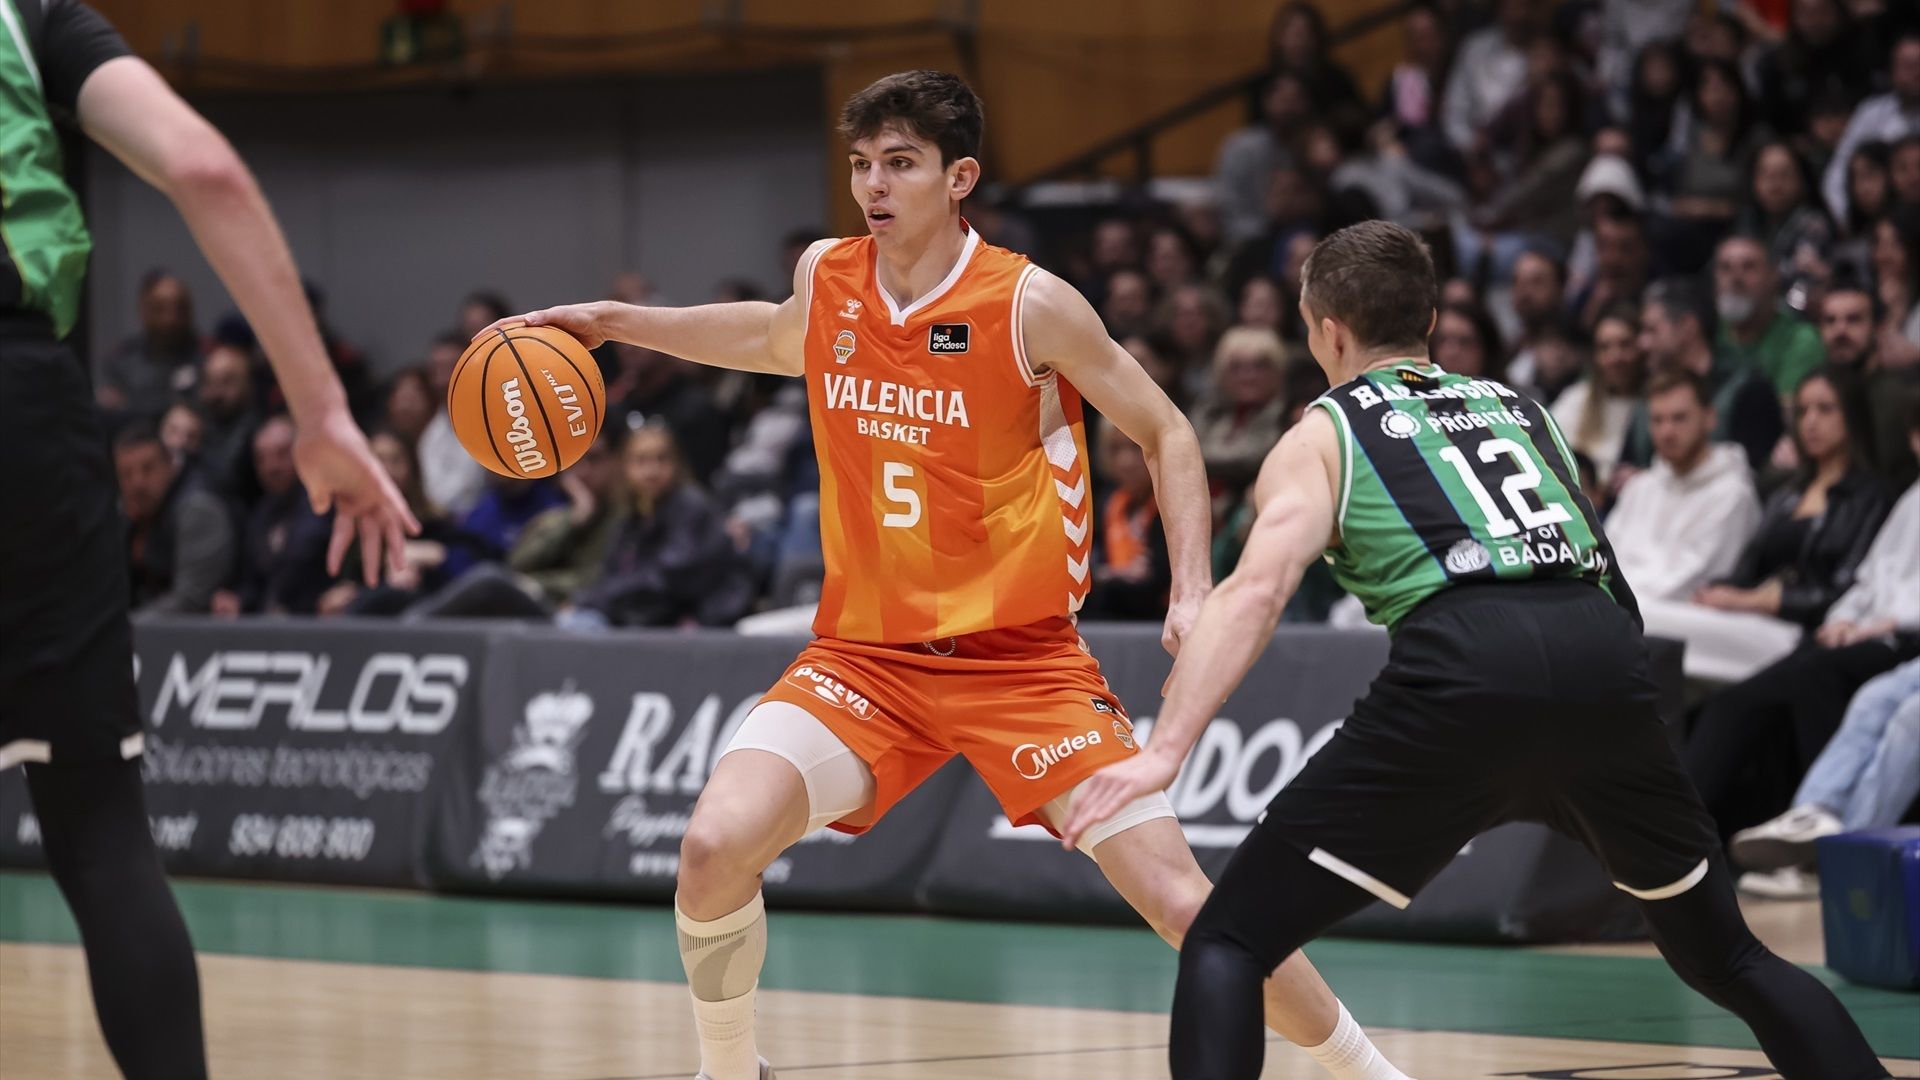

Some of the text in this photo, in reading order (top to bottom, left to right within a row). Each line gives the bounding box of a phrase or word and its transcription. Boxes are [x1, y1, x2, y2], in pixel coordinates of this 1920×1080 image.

[932, 341, 966, 350] endesa
[933, 332, 950, 343] liga
[541, 368, 558, 386] NXT
[823, 373, 970, 428] VALENCIA
[501, 378, 547, 473] Wilson
[857, 417, 931, 445] BASKET
[1425, 409, 1532, 434] PROBITAS
[883, 461, 922, 528] 5
[1439, 437, 1573, 538] 12
[151, 650, 470, 735] MERLOS
[793, 667, 870, 716] PULEVA
[1015, 731, 1102, 779] Midea
